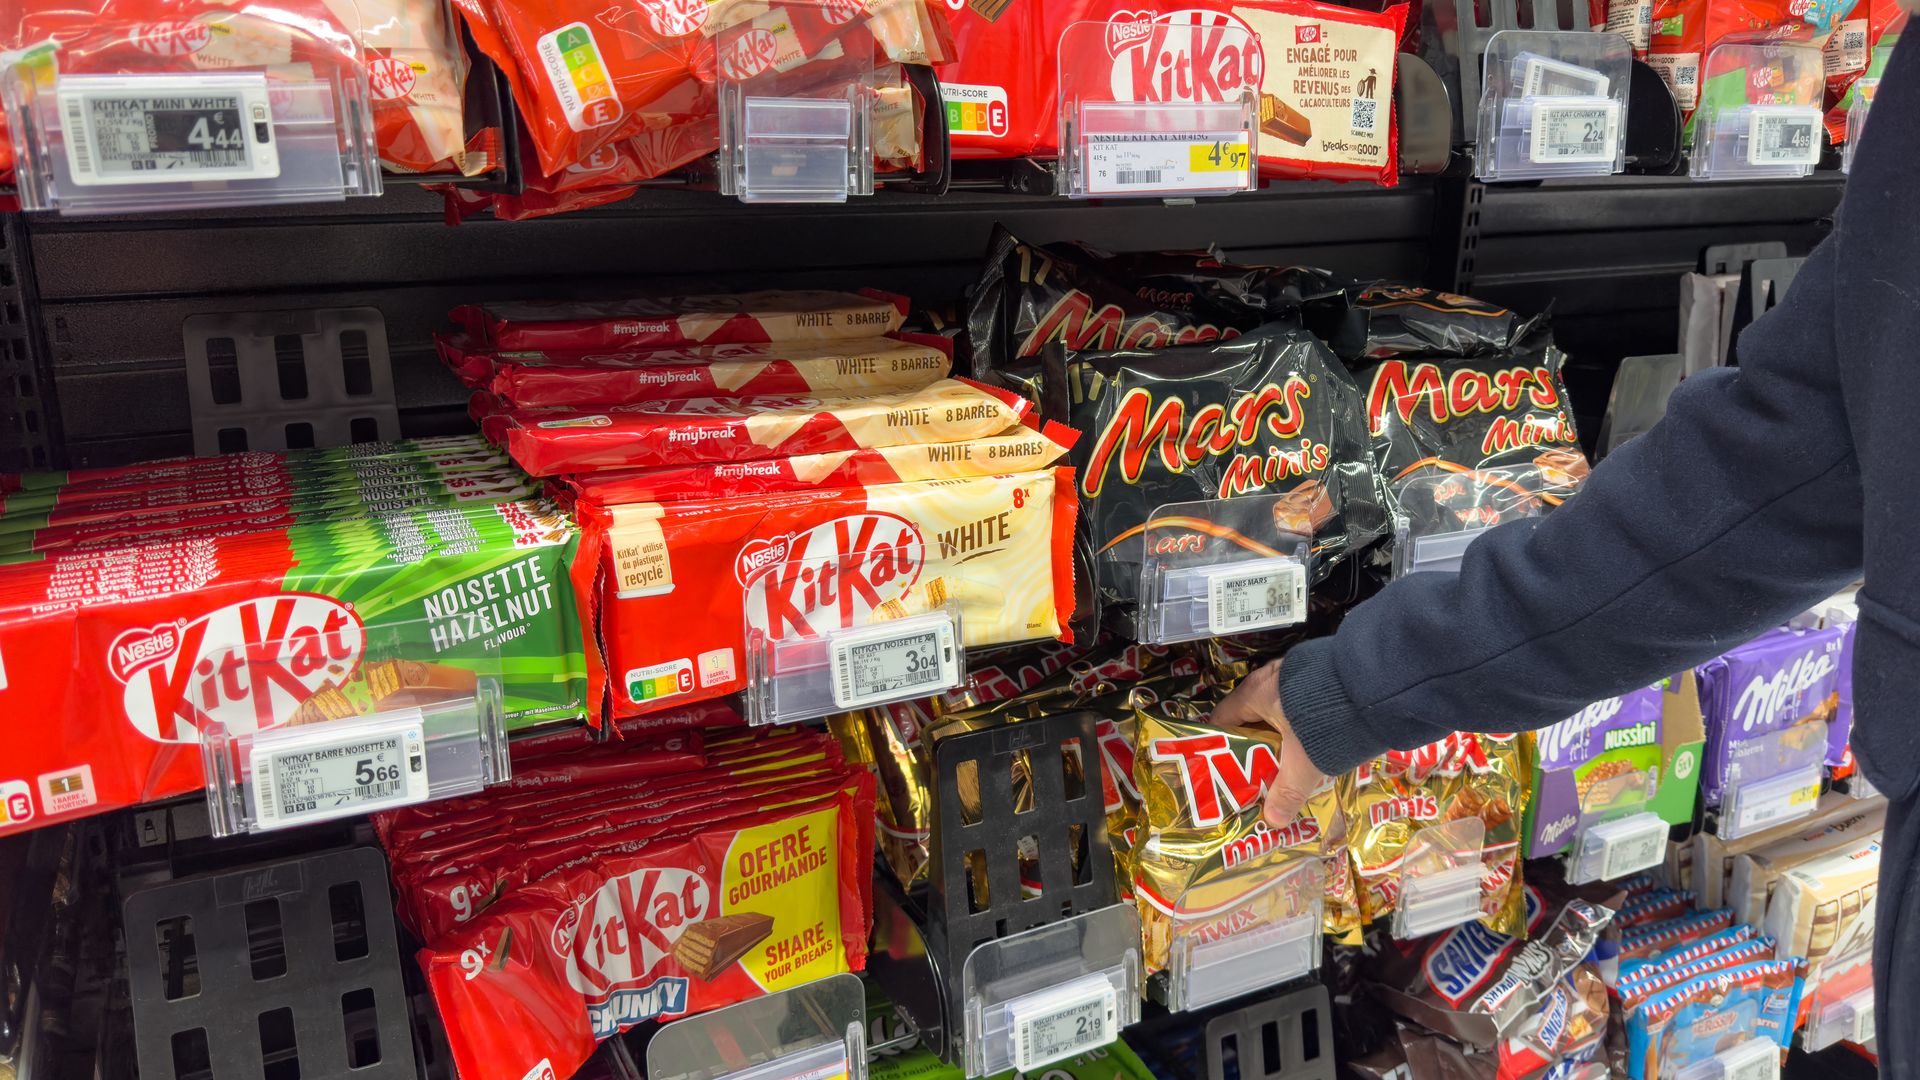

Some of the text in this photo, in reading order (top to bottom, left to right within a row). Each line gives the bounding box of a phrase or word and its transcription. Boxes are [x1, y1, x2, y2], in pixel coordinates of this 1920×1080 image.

[137, 22, 206, 56] KitKat
[1112, 19, 1150, 42] Nestlé
[196, 53, 235, 67] WHITE
[727, 31, 774, 78] KitKat
[774, 50, 801, 66] WHITE
[1131, 12, 1258, 105] KitKat
[1286, 44, 1357, 63] ENGAGÉ POUR
[368, 59, 414, 99] KitKat
[541, 41, 576, 111] NUTRI-SCORE
[1298, 64, 1350, 79] AMÉLIORER LES
[1293, 80, 1351, 96] REVENUS DES
[93, 97, 237, 112] KITKAT MINI WHITE
[592, 103, 608, 122] E
[874, 102, 899, 114] WHITE
[1300, 99, 1351, 108] CACAOCULTEURS
[992, 109, 1004, 127] E
[1357, 144, 1379, 156] GOOD
[613, 322, 670, 336] #mybreak
[796, 311, 891, 327] WHITE 8 BARRES
[836, 355, 941, 376] WHITE 8 BARRES
[639, 370, 701, 385] #mybreak
[1366, 360, 1559, 437] Mars
[886, 404, 999, 427] WHITE 8 BARRES
[668, 426, 737, 445] #mybreak
[1081, 375, 1311, 499] Mars
[1482, 410, 1577, 456] Minis
[928, 441, 1043, 462] WHITE 8 BARRES
[714, 463, 781, 479] #mybreak
[1217, 438, 1329, 500] Minis
[368, 497, 436, 512] NOISETTE
[936, 511, 1011, 561] WHITE
[617, 543, 664, 559] KitKat utilise
[622, 553, 664, 570] du plastique
[742, 538, 787, 572] Nestlé
[624, 564, 664, 587] recyclé
[764, 516, 915, 640] KitKat
[1226, 576, 1268, 589] MINIS MARS
[32, 602, 68, 614] Have
[128, 586, 159, 597] have
[423, 554, 546, 623] NOISETTE
[430, 582, 554, 653] HAZELNUT
[117, 631, 175, 662] Nestlé
[484, 626, 527, 652] FLAVOUR
[852, 636, 923, 656] KITKAT NOISETTE
[147, 598, 351, 741] KitKat
[630, 664, 678, 679] NUTRI-SCORE
[632, 686, 642, 697] A
[645, 683, 654, 694] B
[680, 673, 691, 687] E
[1732, 649, 1835, 732] Milka
[314, 748, 344, 760] BARRE
[345, 741, 385, 755] NOISETTE
[386, 739, 397, 748] X8
[61, 778, 70, 791] 1
[1149, 735, 1280, 828] TW
[12, 798, 28, 815] E
[57, 795, 80, 804] BARRE
[57, 799, 88, 811] PORTION
[1541, 814, 1577, 846] Milka
[739, 824, 812, 878] OFFRE
[729, 845, 828, 906] GOURMANDE
[572, 870, 701, 991] KitKat
[765, 920, 824, 967] SHARE
[764, 938, 833, 984] YOUR BREAKS
[590, 981, 683, 1035] CHUNKY
[1033, 1008, 1077, 1027] BISCUIT SECRET
